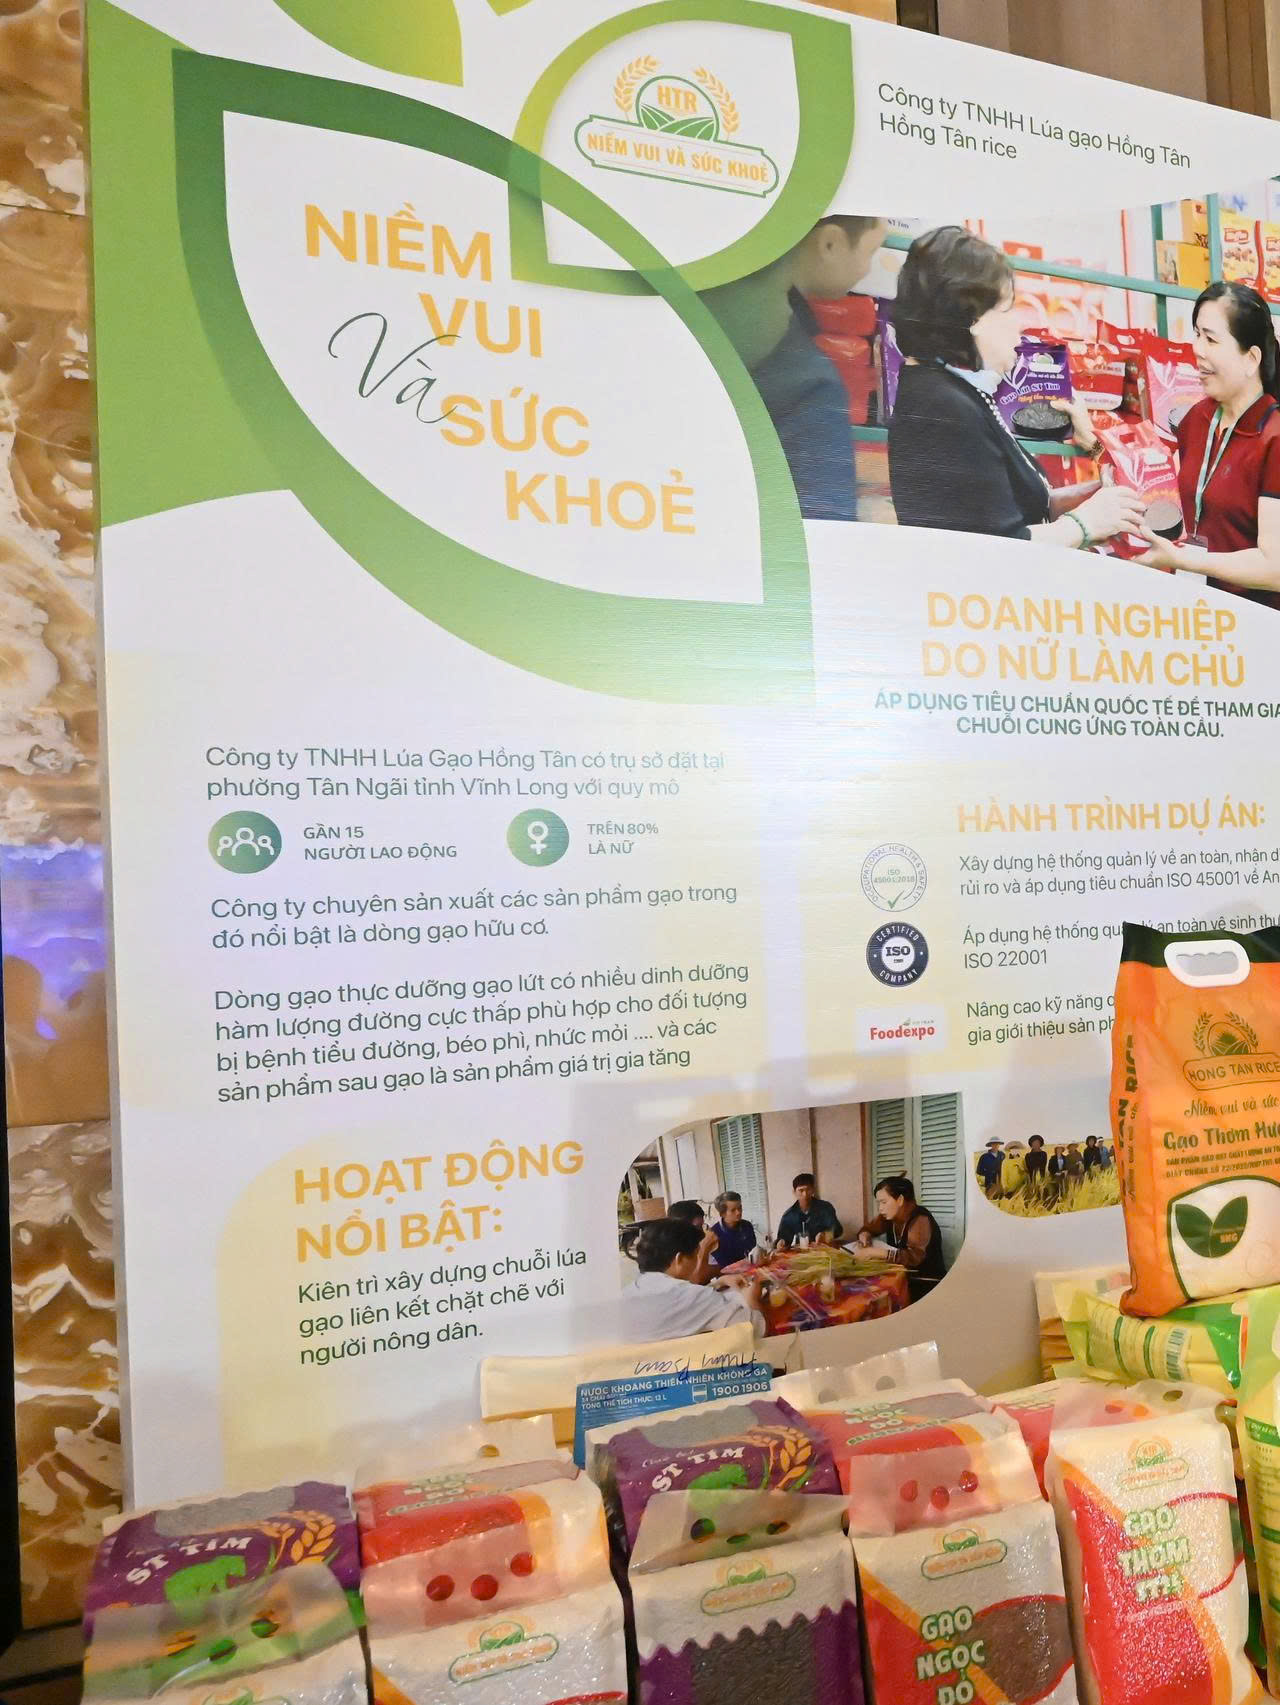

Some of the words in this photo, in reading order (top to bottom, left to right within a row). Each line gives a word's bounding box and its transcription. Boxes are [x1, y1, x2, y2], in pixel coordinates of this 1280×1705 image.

[657, 85, 698, 113] HTR
[878, 83, 934, 115] Công
[939, 97, 957, 120] ty
[963, 101, 1024, 132] TNHH
[1030, 116, 1063, 141] Lúa
[1068, 129, 1102, 150] gạo
[1107, 133, 1154, 164] Hồng
[1160, 146, 1191, 168] Tân
[880, 110, 935, 145] Hồng
[941, 126, 976, 151] Tân
[982, 137, 1017, 159] rice
[633, 142, 660, 162] VUI
[305, 202, 492, 283] NIỀM
[418, 292, 543, 359] VUI
[328, 312, 463, 423] Và
[440, 386, 589, 458] SỨC
[926, 592, 1083, 636] DOANH
[1094, 598, 1237, 648] NGHIỆP
[921, 641, 987, 678] DO
[999, 636, 1061, 681] NỮ
[1068, 641, 1154, 687] LÀM
[1163, 642, 1246, 688] CHỦ
[874, 687, 902, 711] ÁP
[907, 693, 968, 714] DỤNG
[972, 690, 1015, 713] TIÊU
[1021, 692, 1090, 715] CHUẨN
[1095, 696, 1148, 716] QUỐC
[1152, 695, 1174, 716] TẾ
[1204, 700, 1254, 718] THAM
[956, 715, 1021, 735] CHUỖI
[1026, 717, 1082, 736] CUNG
[1086, 714, 1127, 737] ỨNG
[1131, 716, 1180, 738] TOÀN
[1184, 719, 1224, 739] CẦU.
[588, 820, 624, 835] TRÊN
[627, 823, 659, 835] 80%
[958, 795, 1057, 834] HÀNH
[1064, 794, 1160, 832] TRÌNH
[1168, 797, 1211, 836] DỰ
[1218, 794, 1266, 830] ÁN:
[303, 822, 340, 840] GẦN
[346, 826, 364, 839] 15
[304, 846, 365, 861] NGƯỜI
[370, 847, 403, 859] LAO
[407, 843, 457, 862] ĐỘNG
[589, 842, 606, 855] LÀ
[610, 840, 634, 855] NỮ
[887, 868, 900, 876] ISO
[212, 898, 277, 921] Công
[285, 899, 306, 919] ty
[313, 894, 397, 916] chuyên
[404, 892, 443, 911] sản
[449, 887, 494, 909] xuất
[501, 889, 538, 908] các
[543, 888, 579, 907] sản
[586, 882, 641, 908] phẩm
[647, 888, 683, 907] gạo
[688, 885, 737, 904] trong
[876, 925, 920, 942] CERTIFIED
[886, 945, 910, 957] ISO
[964, 952, 994, 969] ISO
[997, 950, 1048, 968] 22001
[879, 968, 919, 983] COMPANY
[870, 1025, 935, 1041] Foodexpo
[1189, 1066, 1226, 1081] HONG
[1229, 1063, 1254, 1075] TAN
[1163, 1131, 1199, 1153] Gạo
[1203, 1127, 1250, 1146] Thơm
[294, 1154, 432, 1206] HOẠT
[443, 1138, 585, 1189] ĐỘNG
[295, 1210, 387, 1265] NỔI
[399, 1198, 504, 1253] BẬT:
[298, 1278, 352, 1304] Kiên
[356, 1272, 380, 1298] trì
[385, 1270, 425, 1296] xây
[429, 1260, 487, 1289] dựng
[492, 1248, 552, 1276] chuỗi
[555, 1246, 588, 1272] lúa
[712, 1385, 740, 1396] 1900
[741, 1382, 768, 1393] 1906
[652, 1463, 684, 1491] ST
[126, 1554, 169, 1585] ST
[920, 1605, 974, 1641] GẠO
[916, 1639, 985, 1680] NGỌC
